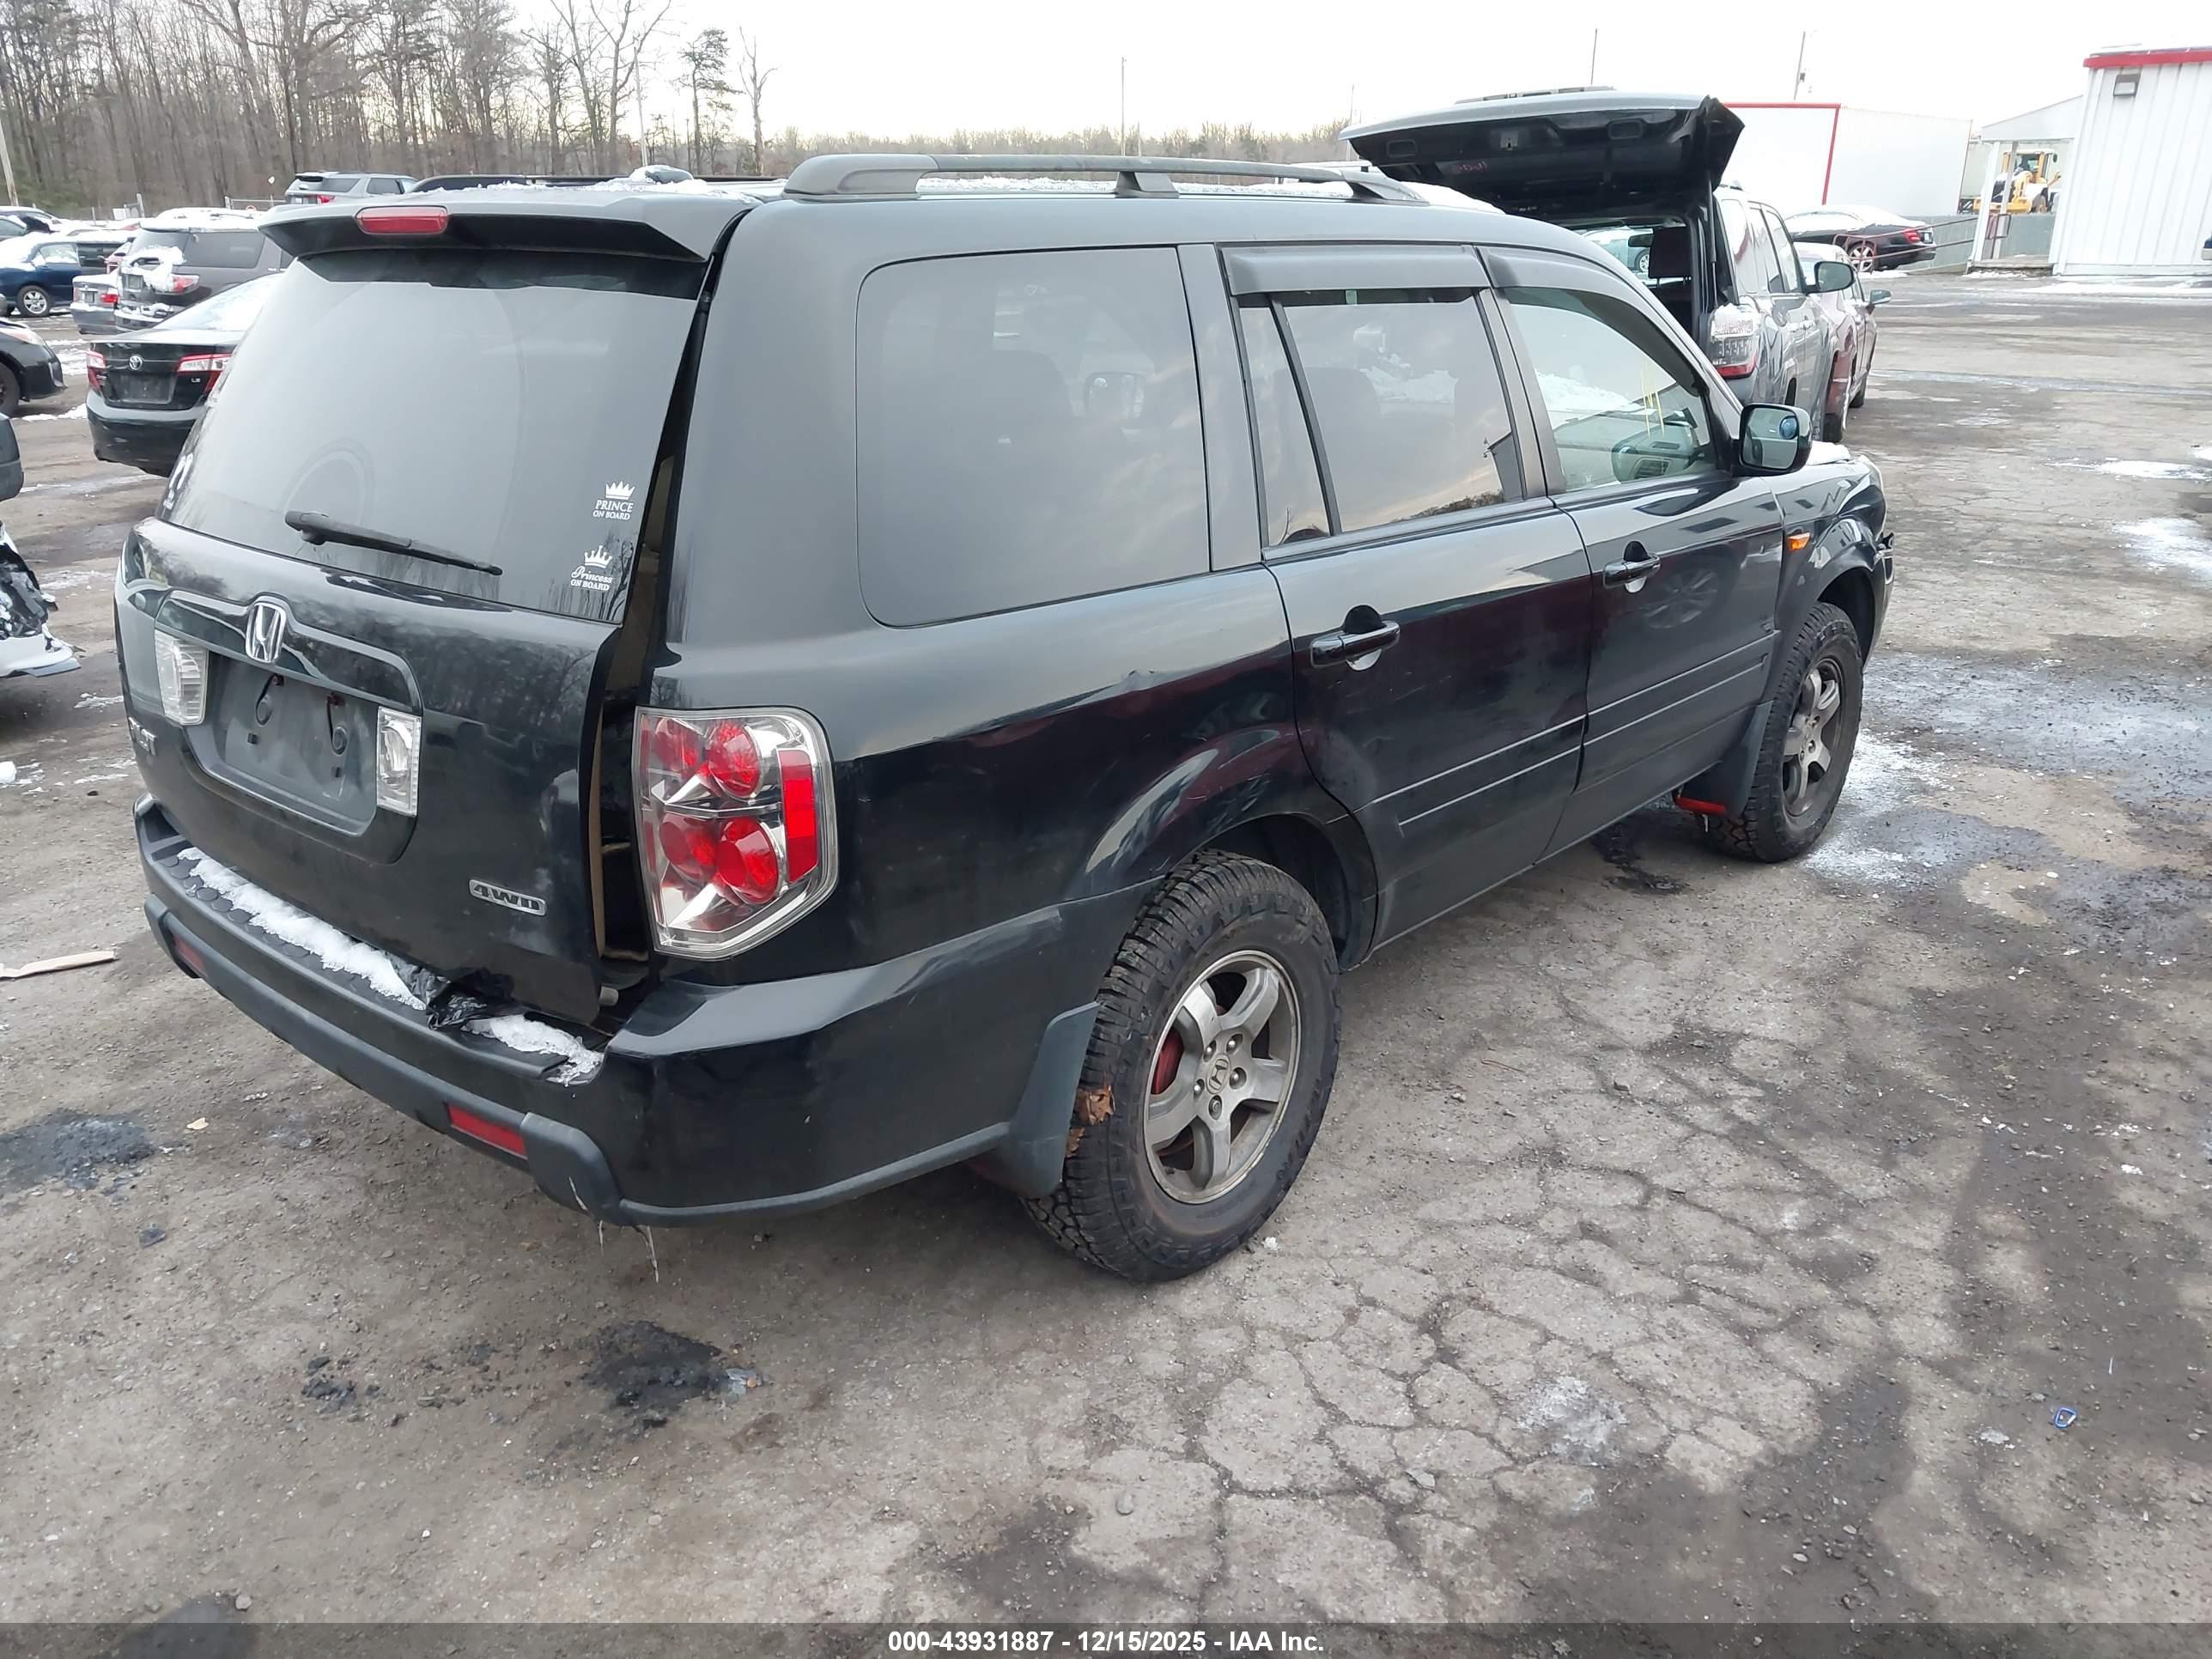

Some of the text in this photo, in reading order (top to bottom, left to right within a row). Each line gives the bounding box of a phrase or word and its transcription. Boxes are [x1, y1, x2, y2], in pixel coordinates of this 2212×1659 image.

[594, 499, 635, 514] PRINCE
[592, 509, 631, 521] ON BOARD
[570, 565, 613, 585] Princess
[569, 578, 611, 592] ON BOARD
[471, 883, 543, 912] 4WD
